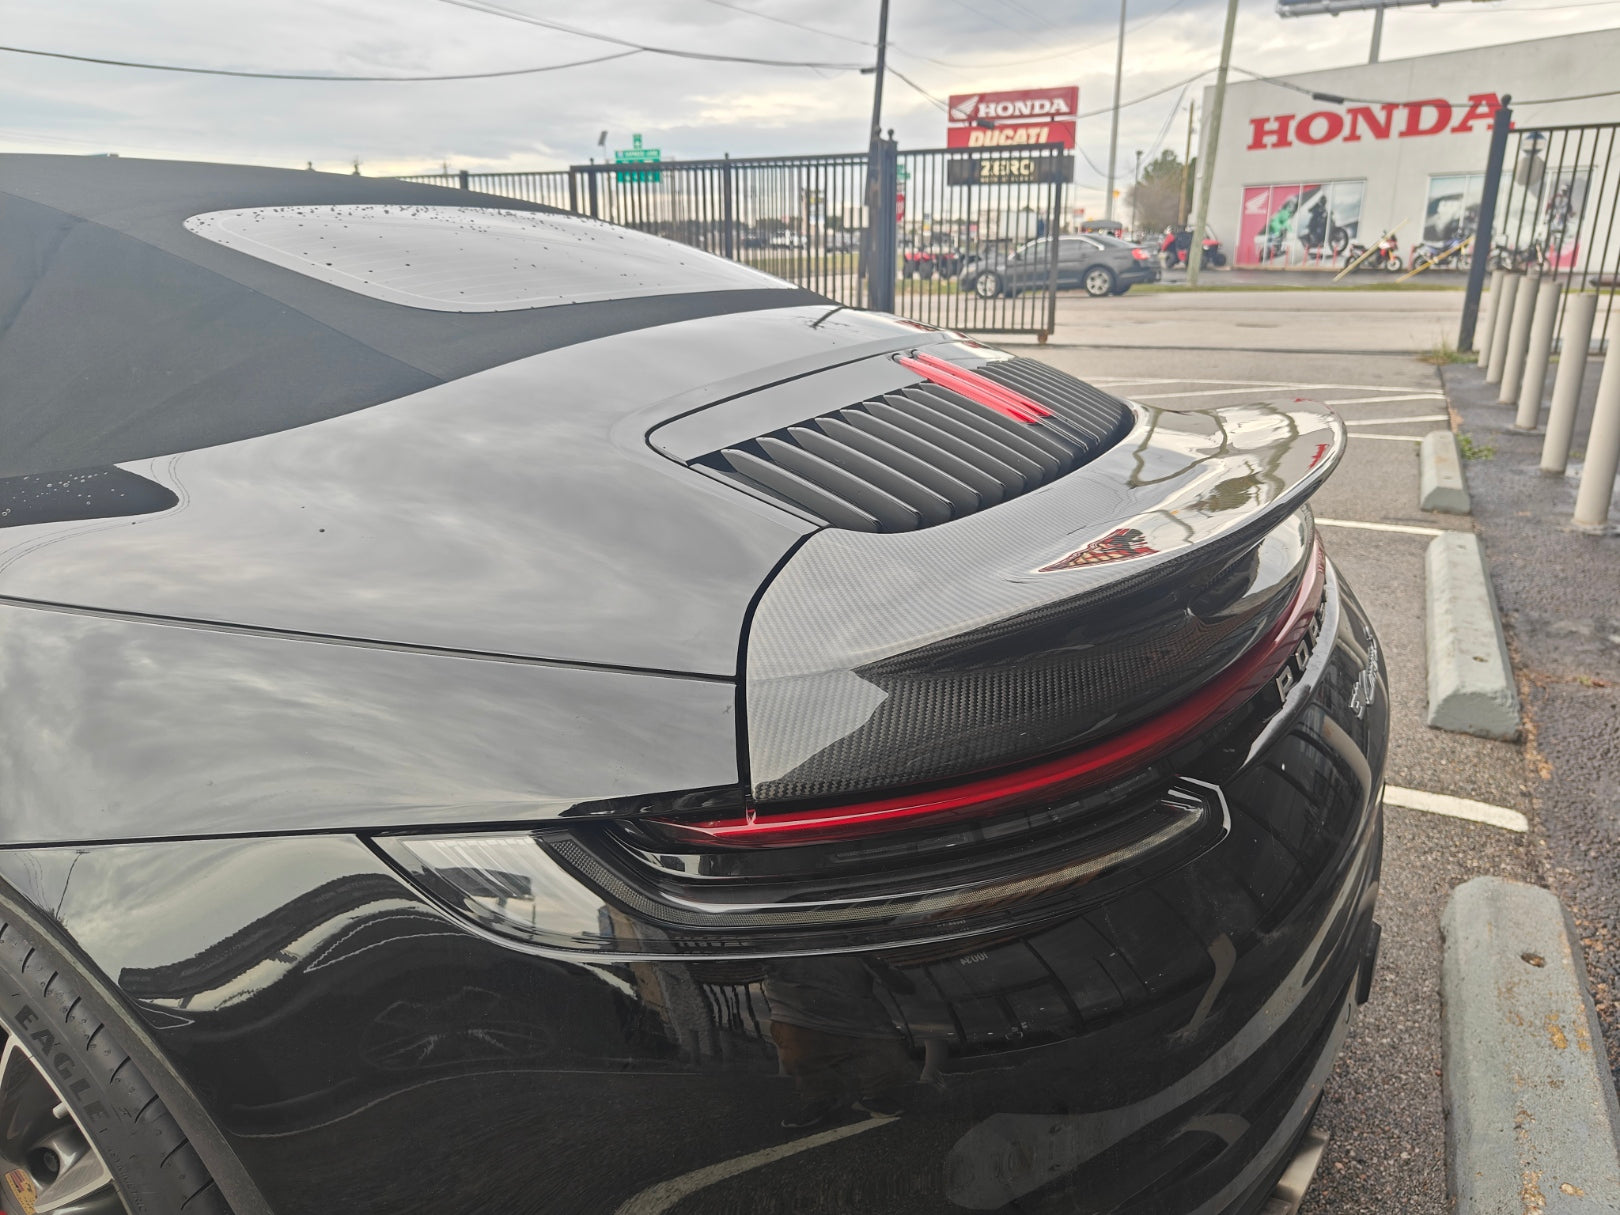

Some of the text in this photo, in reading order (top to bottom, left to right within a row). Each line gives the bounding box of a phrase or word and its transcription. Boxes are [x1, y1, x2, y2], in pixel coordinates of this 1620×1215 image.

[977, 98, 1070, 118] HONDA
[1247, 92, 1515, 150] HONDA
[968, 126, 1050, 148] DUCATI
[980, 159, 1035, 176] ZERO
[14, 1004, 111, 1122] EAGLE
